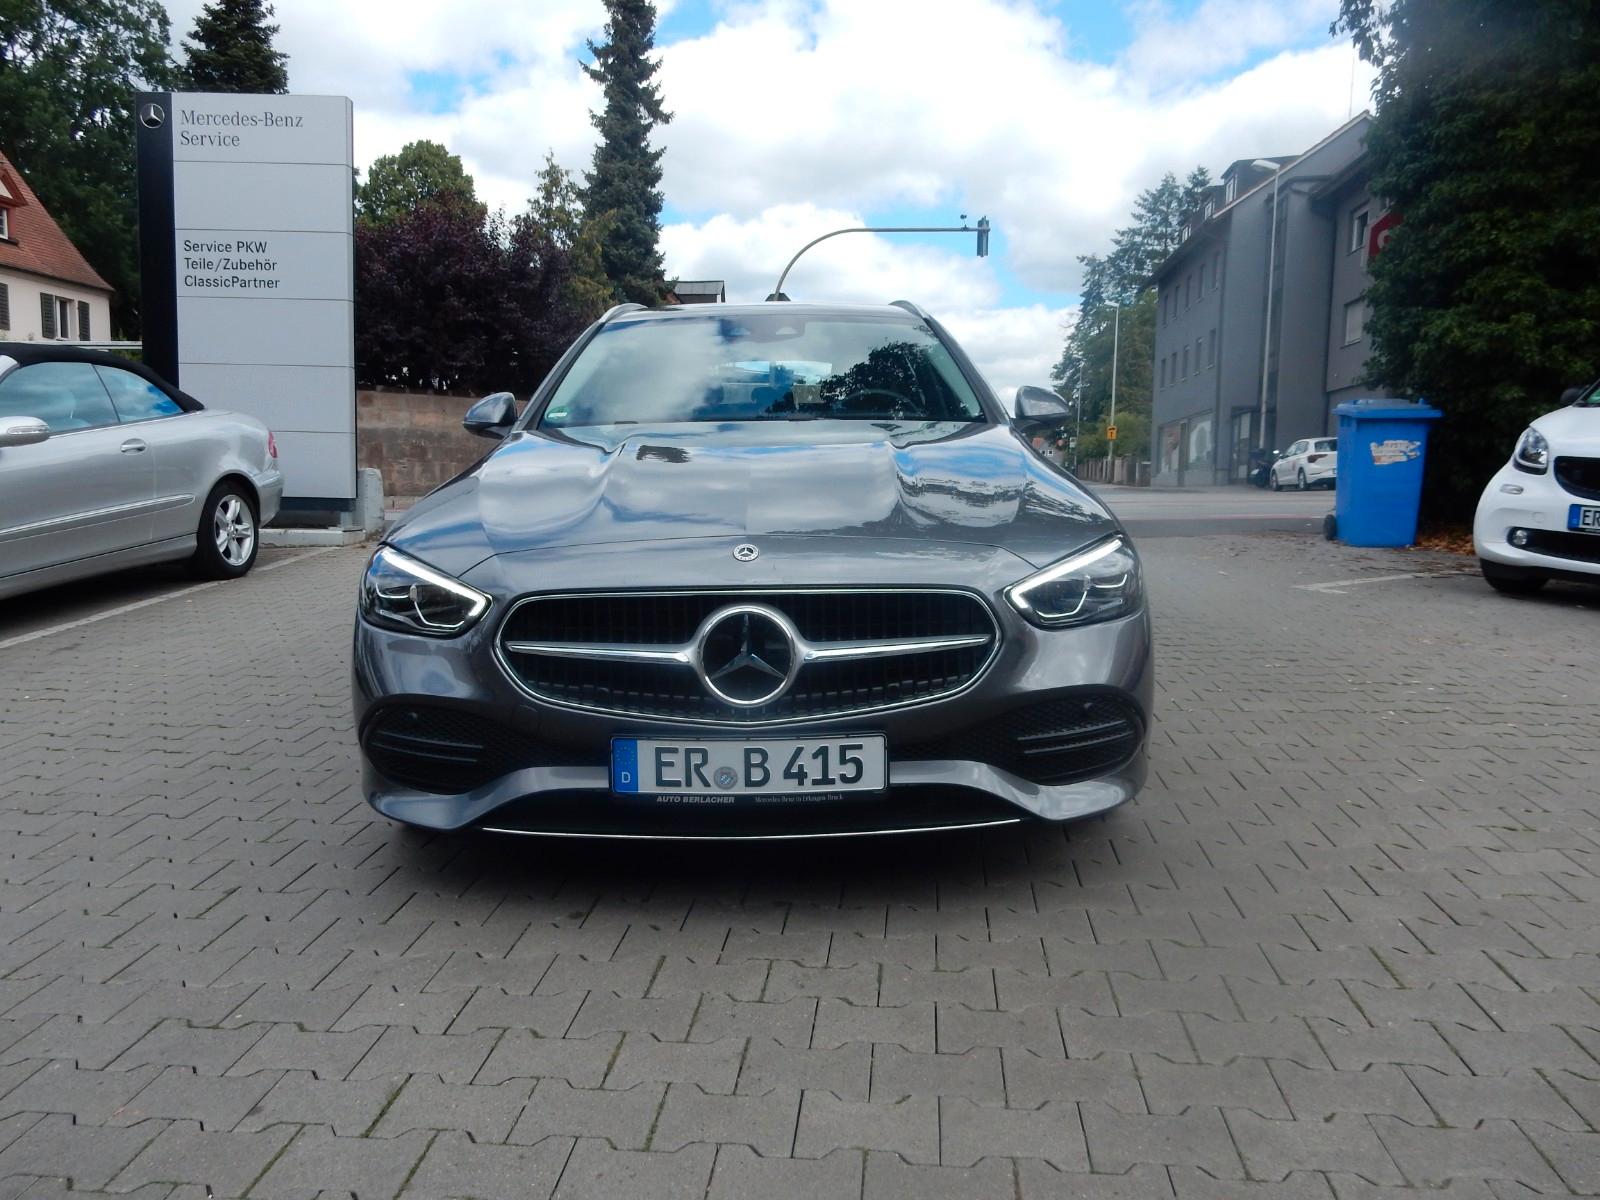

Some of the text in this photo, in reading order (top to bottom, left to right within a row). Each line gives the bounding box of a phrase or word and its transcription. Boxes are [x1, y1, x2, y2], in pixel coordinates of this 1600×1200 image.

[180, 110, 303, 128] Mercedes-Benz
[180, 131, 240, 147] Service
[183, 240, 267, 254] Service PKW
[184, 257, 277, 272] Teile/Zubehör
[184, 275, 280, 289] ClassicPartner
[655, 743, 864, 788] ER B 415
[621, 772, 631, 784] D
[656, 795, 735, 804] AUTO BERLACHER
